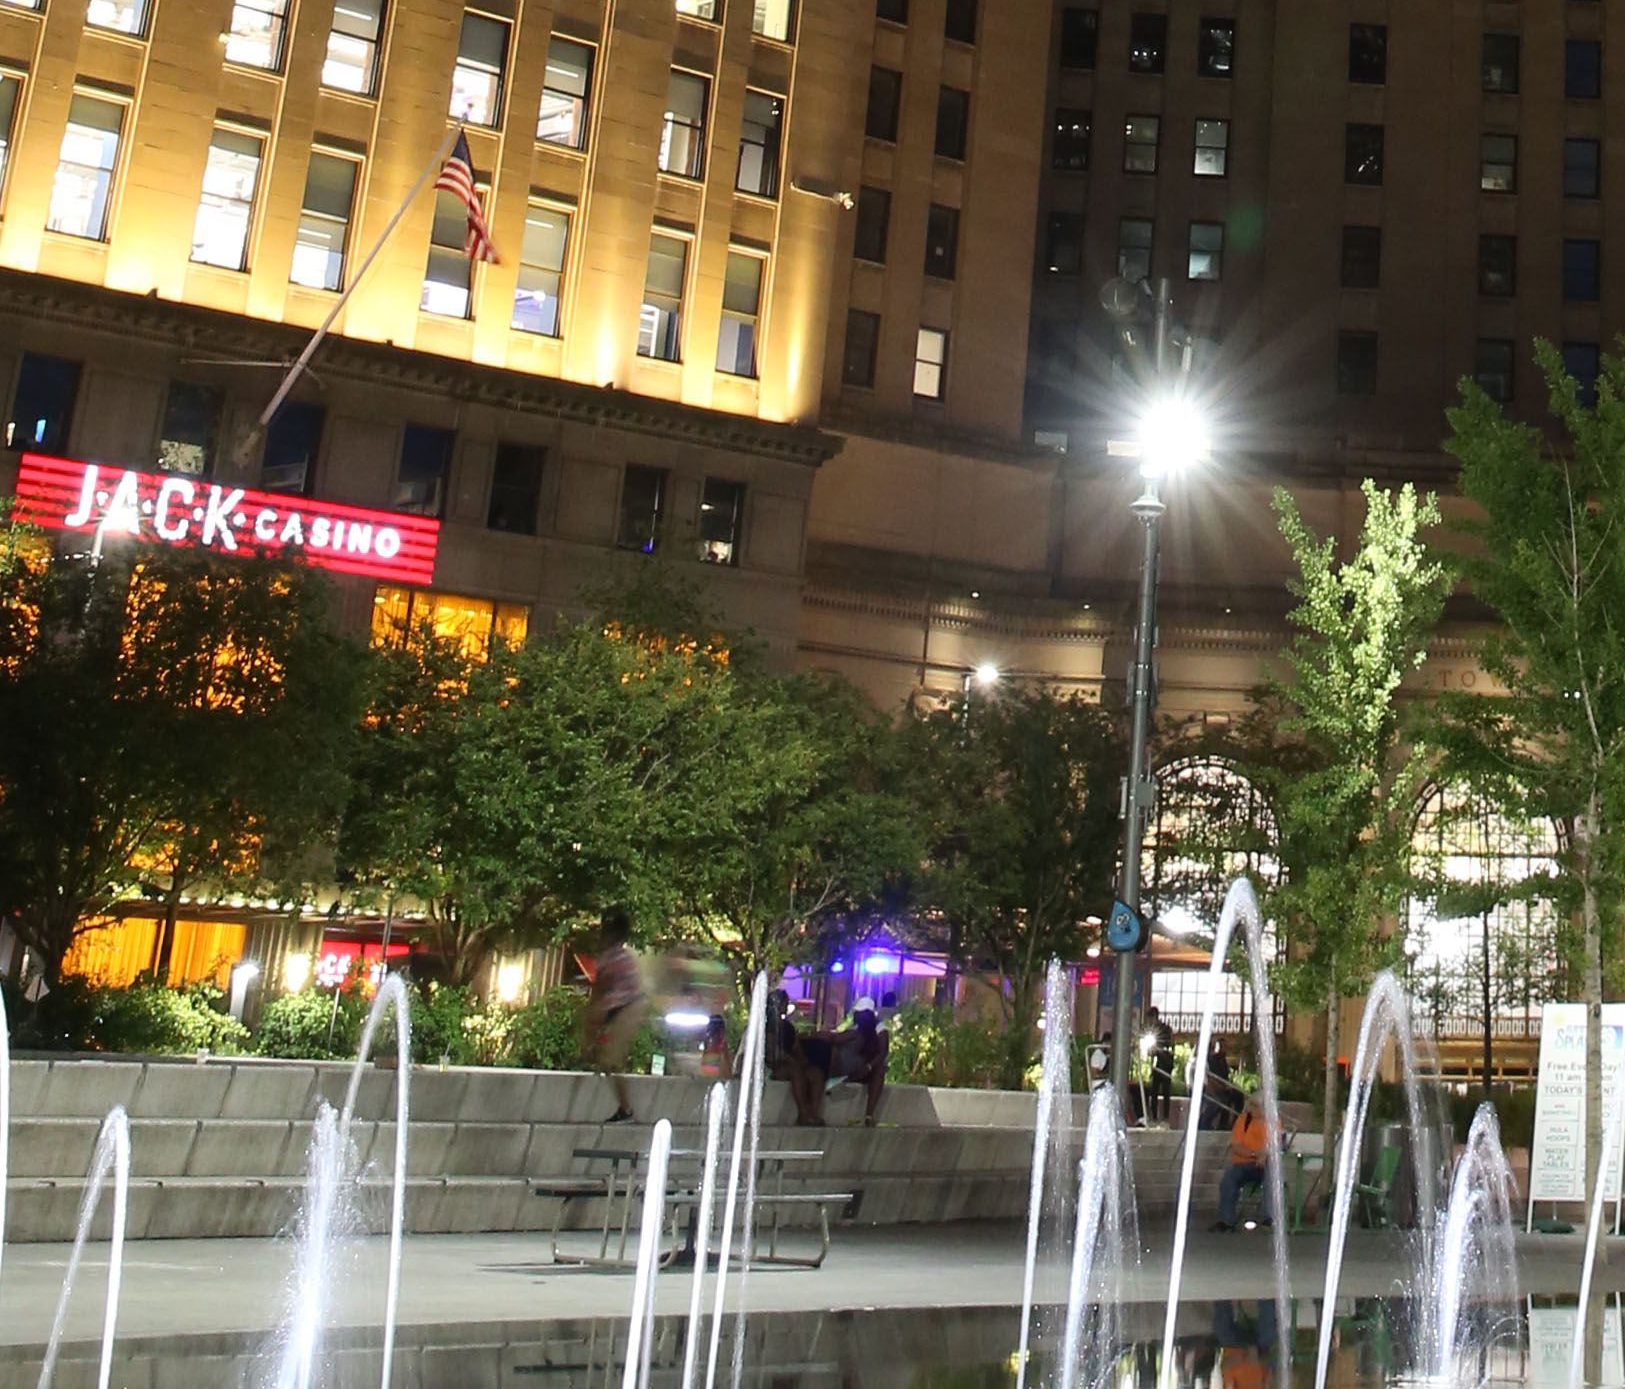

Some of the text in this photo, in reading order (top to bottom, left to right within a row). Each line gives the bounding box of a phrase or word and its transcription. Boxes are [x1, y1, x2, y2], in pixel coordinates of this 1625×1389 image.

[254, 508, 401, 558] CASINO
[1547, 1062, 1568, 1070] Free
[1544, 1085, 1583, 1094] TODAY'S
